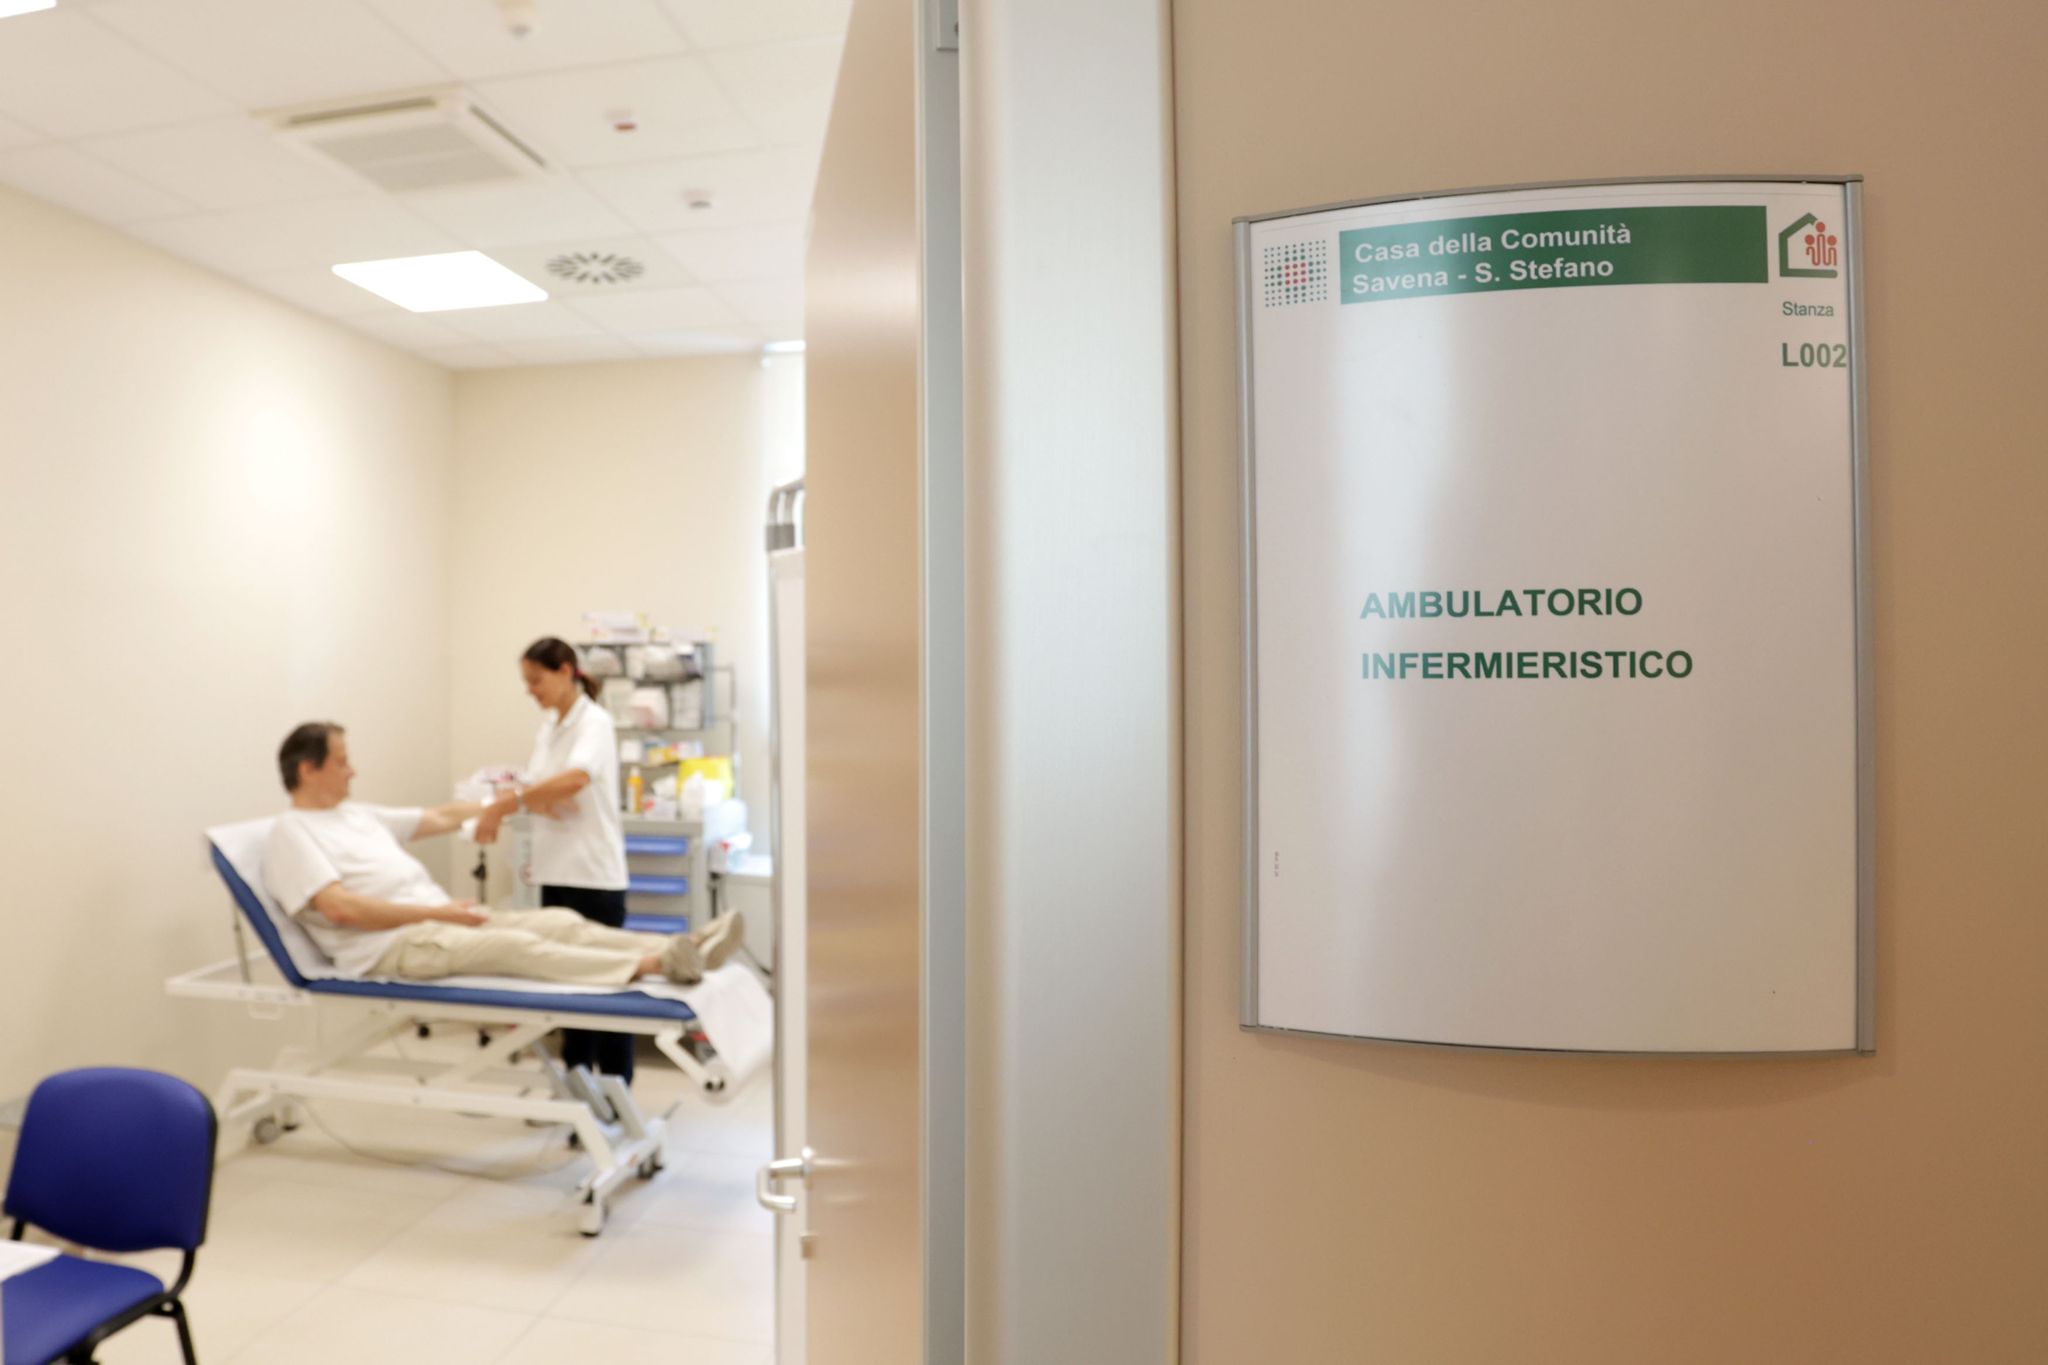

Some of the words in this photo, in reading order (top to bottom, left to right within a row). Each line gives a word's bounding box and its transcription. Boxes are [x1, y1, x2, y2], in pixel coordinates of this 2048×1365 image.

[1354, 241, 1420, 264] Casa
[1428, 234, 1492, 257] della
[1501, 222, 1632, 250] Comunità
[1352, 269, 1449, 295] Savena
[1475, 261, 1501, 284] S.
[1509, 257, 1615, 283] Stefano
[1782, 301, 1834, 317] Stanza
[1782, 343, 1847, 367] L002
[1360, 588, 1643, 619] AMBULATORIO
[1362, 650, 1693, 680] INFERMIERISTICO
